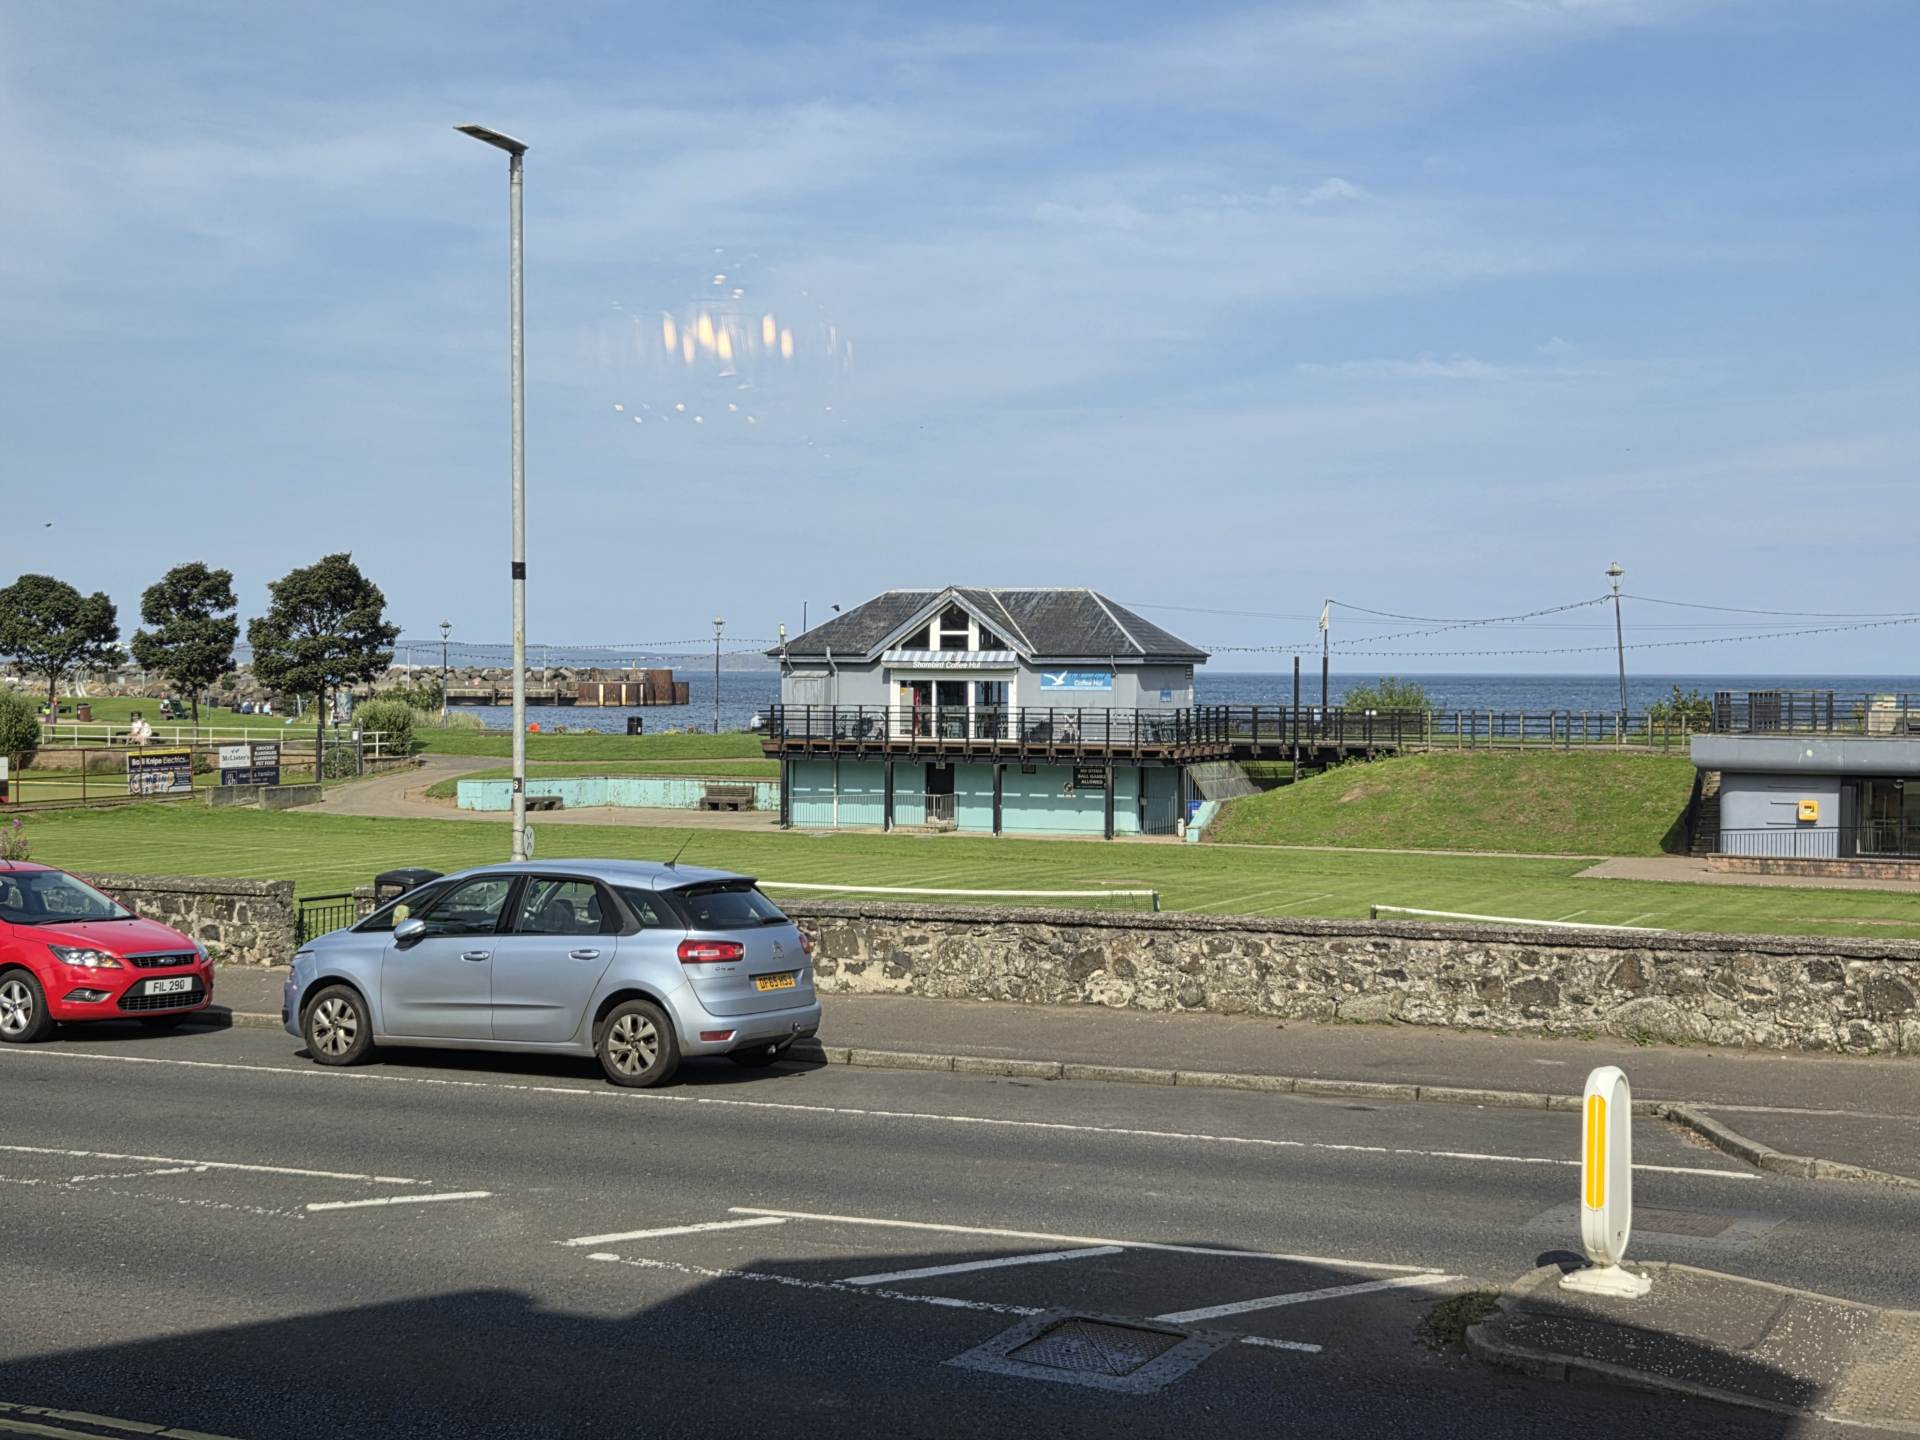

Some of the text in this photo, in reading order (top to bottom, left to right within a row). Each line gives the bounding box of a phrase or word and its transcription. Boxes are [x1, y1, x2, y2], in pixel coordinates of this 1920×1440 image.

[945, 661, 968, 669] Coffee
[968, 661, 982, 669] Hut
[153, 979, 185, 992] FIL 290
